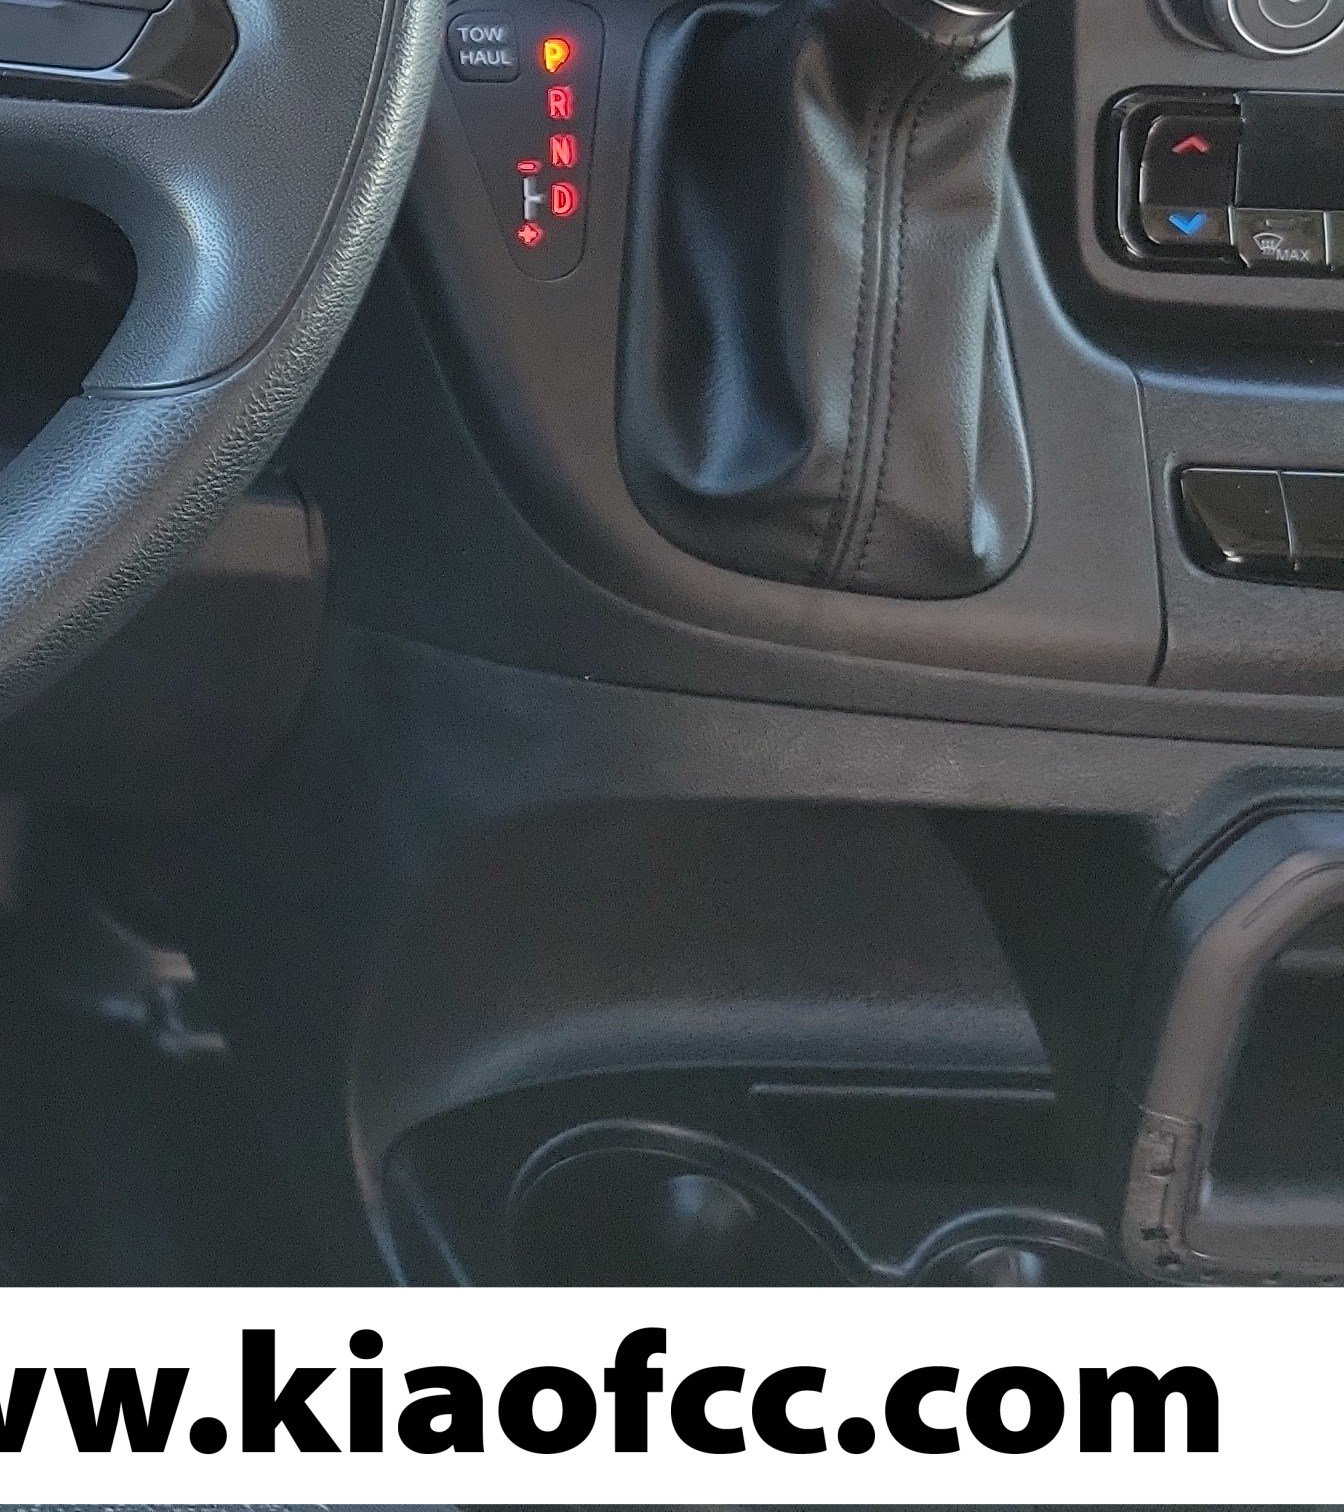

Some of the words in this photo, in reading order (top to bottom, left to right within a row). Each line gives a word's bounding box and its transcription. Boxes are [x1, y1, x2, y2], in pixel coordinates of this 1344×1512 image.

[457, 26, 504, 45] TOW
[459, 48, 513, 66] HAUL
[543, 37, 571, 73] P
[547, 86, 572, 120] R
[550, 134, 575, 168] N
[551, 182, 575, 216] D
[1275, 248, 1311, 263] MAX
